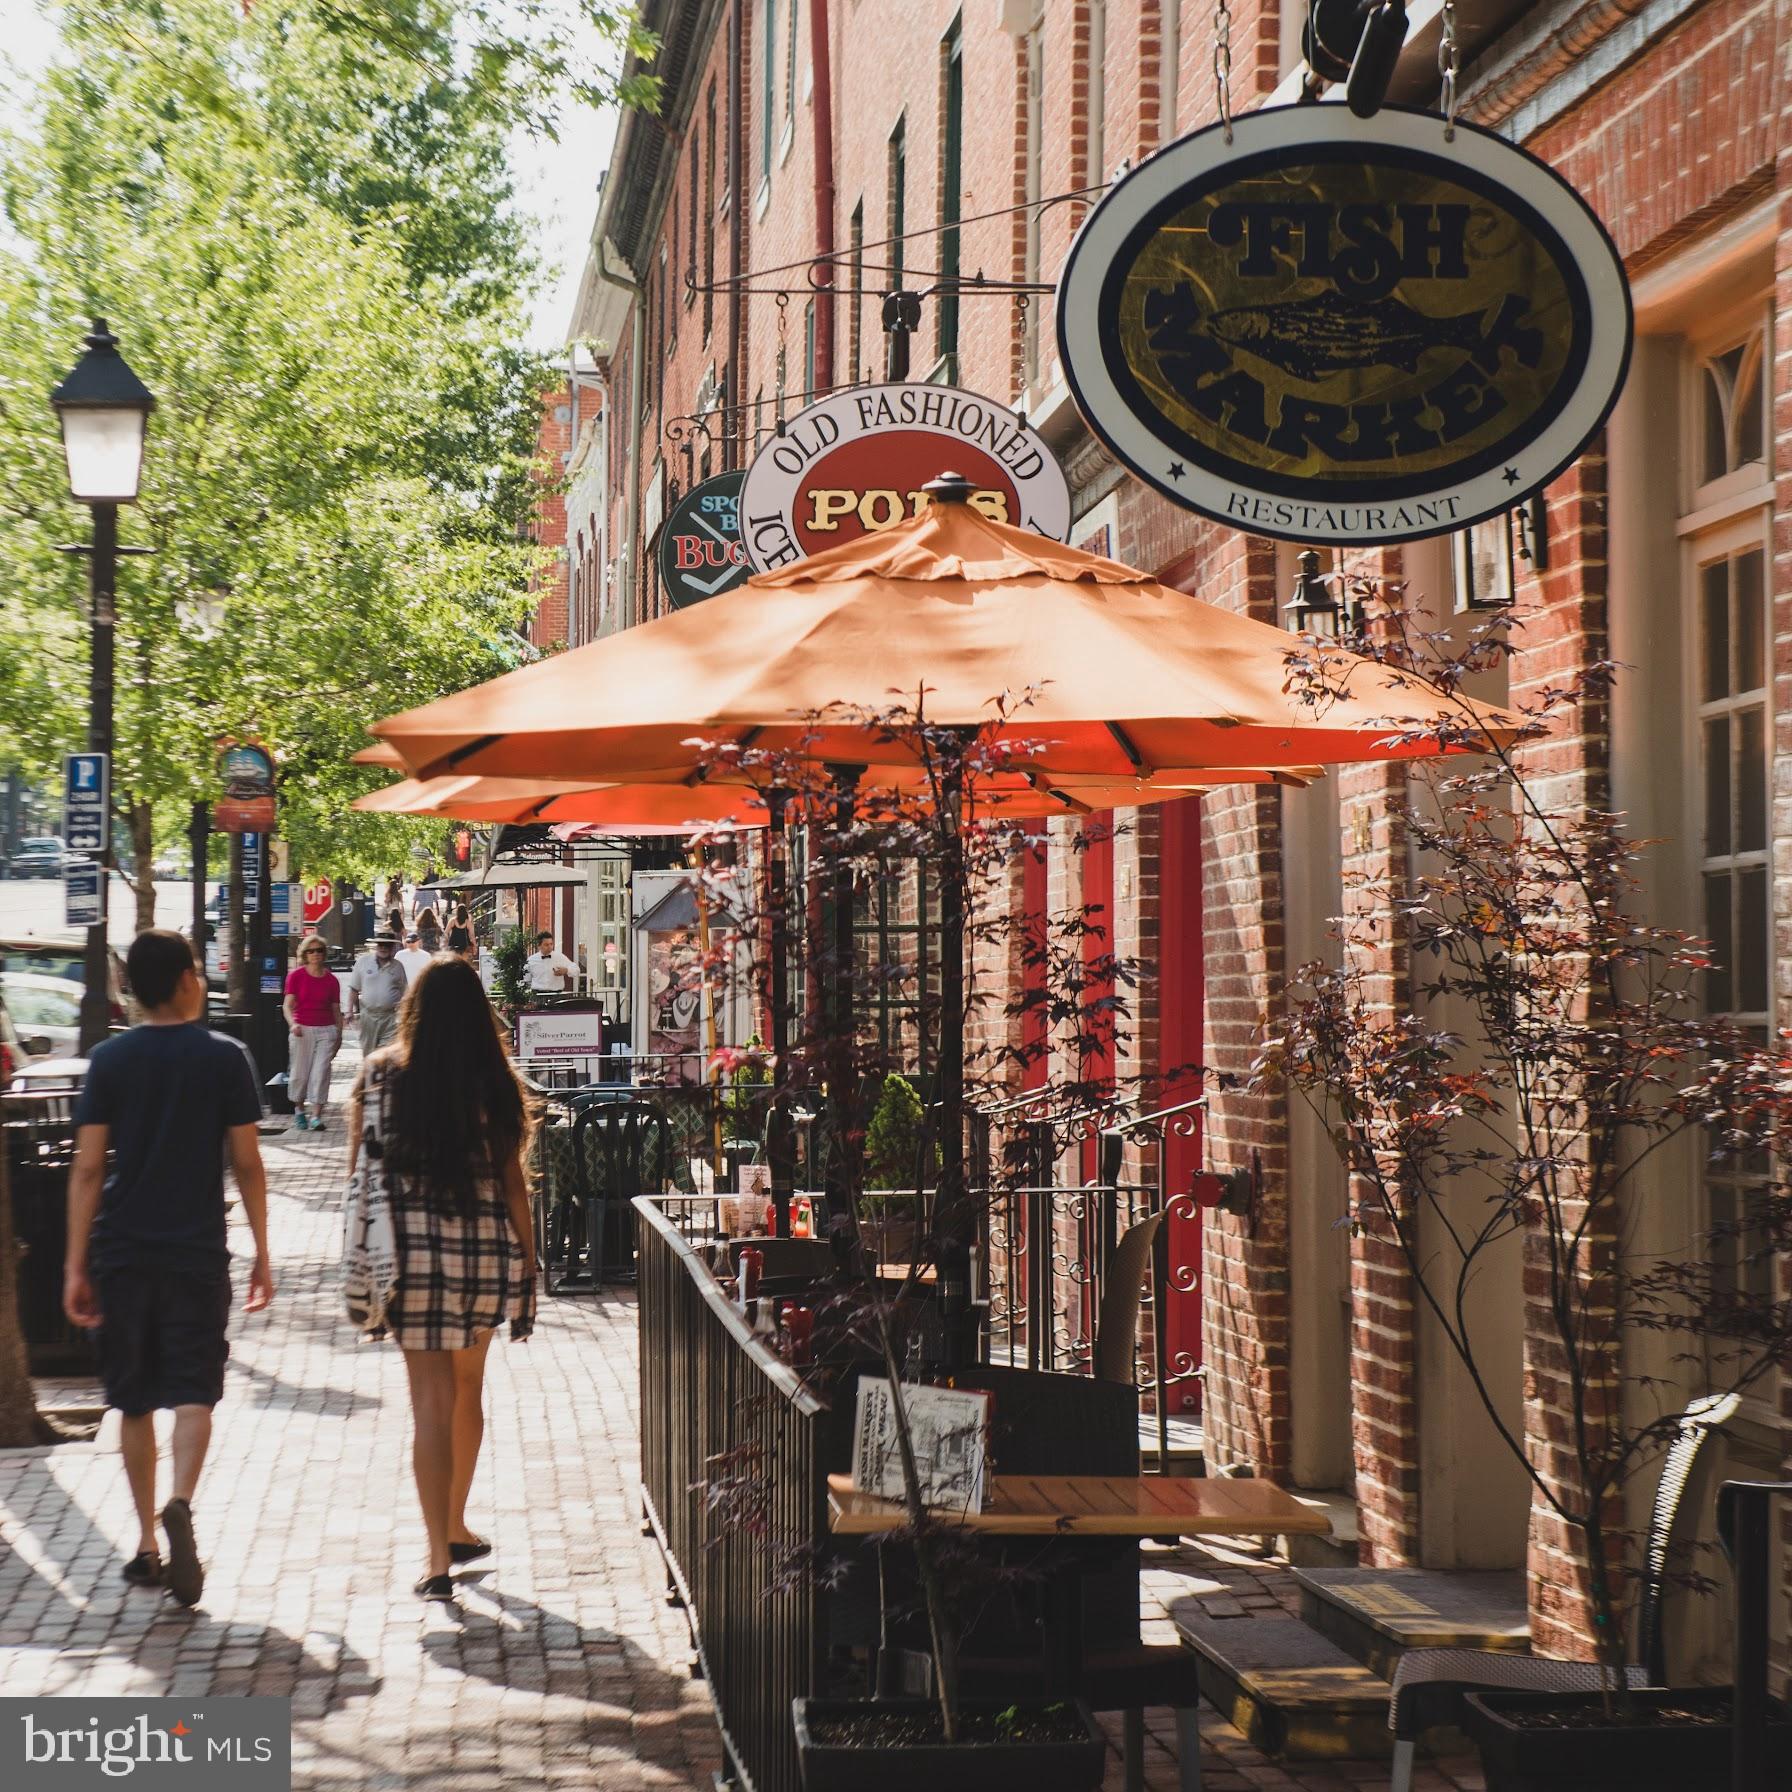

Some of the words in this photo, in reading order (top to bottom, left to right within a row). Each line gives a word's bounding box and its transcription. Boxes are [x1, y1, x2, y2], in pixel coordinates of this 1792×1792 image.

[1207, 203, 1471, 300] FISH
[1143, 280, 1544, 462] MARKET
[772, 413, 839, 476] OLD
[856, 390, 1044, 481] FASHIONED
[719, 514, 738, 531] B
[1226, 491, 1462, 531] RESTAURANT
[76, 760, 95, 787] P
